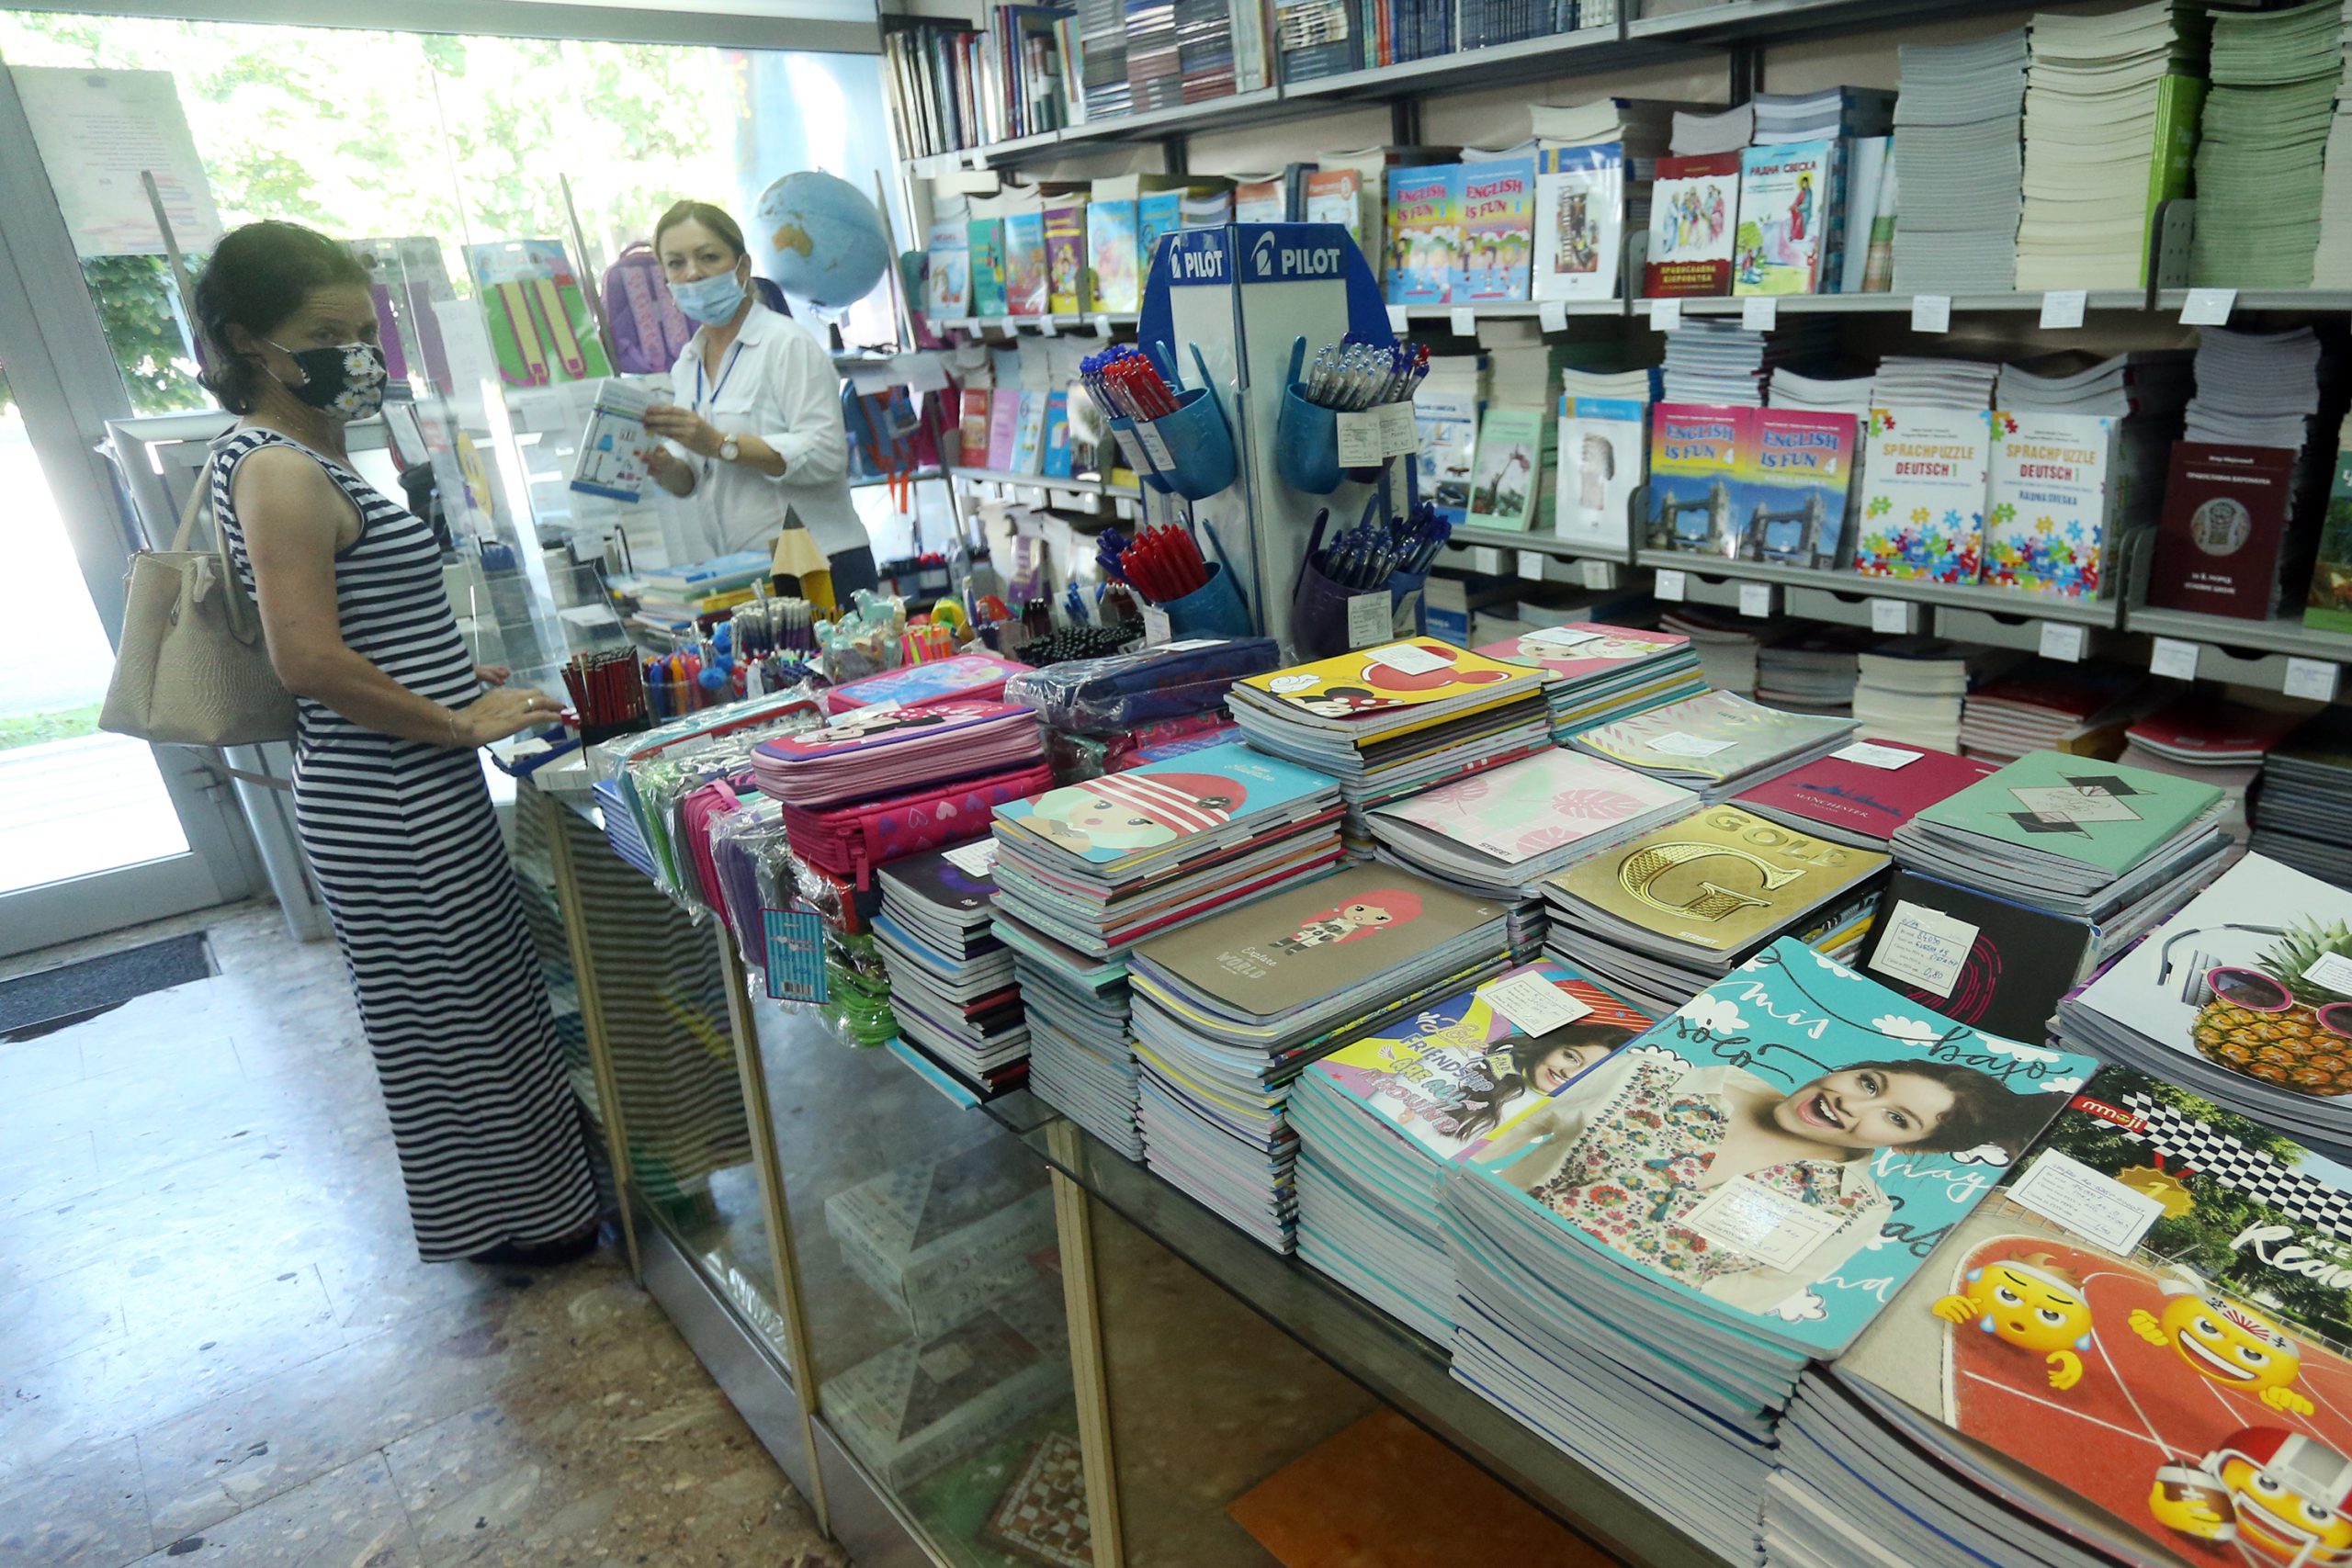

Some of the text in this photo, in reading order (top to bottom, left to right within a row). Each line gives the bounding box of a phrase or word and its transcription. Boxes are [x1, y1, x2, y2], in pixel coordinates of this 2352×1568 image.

[1396, 185, 1447, 203] ENGLISH
[1464, 179, 1523, 199] ENGLISH
[1396, 208, 1408, 221] IS
[1410, 203, 1434, 220] FUN
[1464, 205, 1477, 220] IS
[1479, 199, 1507, 217] FUN
[1183, 250, 1223, 278] PILOT
[1281, 248, 1341, 276] PILOT
[1665, 423, 1736, 444] ENGLISH
[1762, 427, 1839, 451] ENGLISH
[1664, 444, 1736, 465] IS FUN 4
[1883, 442, 1975, 461] SPRACHPUZZLE
[2006, 442, 2098, 466] SPRACHPUZZLE
[1759, 452, 1838, 475] IS FUN 4
[1895, 461, 1950, 477] DEUTSCH
[2019, 463, 2073, 482] DEUTSCH
[1793, 793, 1869, 818] MANCHESTER
[1478, 841, 1512, 858] STREET
[1678, 930, 1721, 945] STREET
[1398, 1032, 1496, 1093] FRIENDSHIP
[1927, 1026, 2074, 1087] bajo
[1355, 1067, 1461, 1134] AROUND
